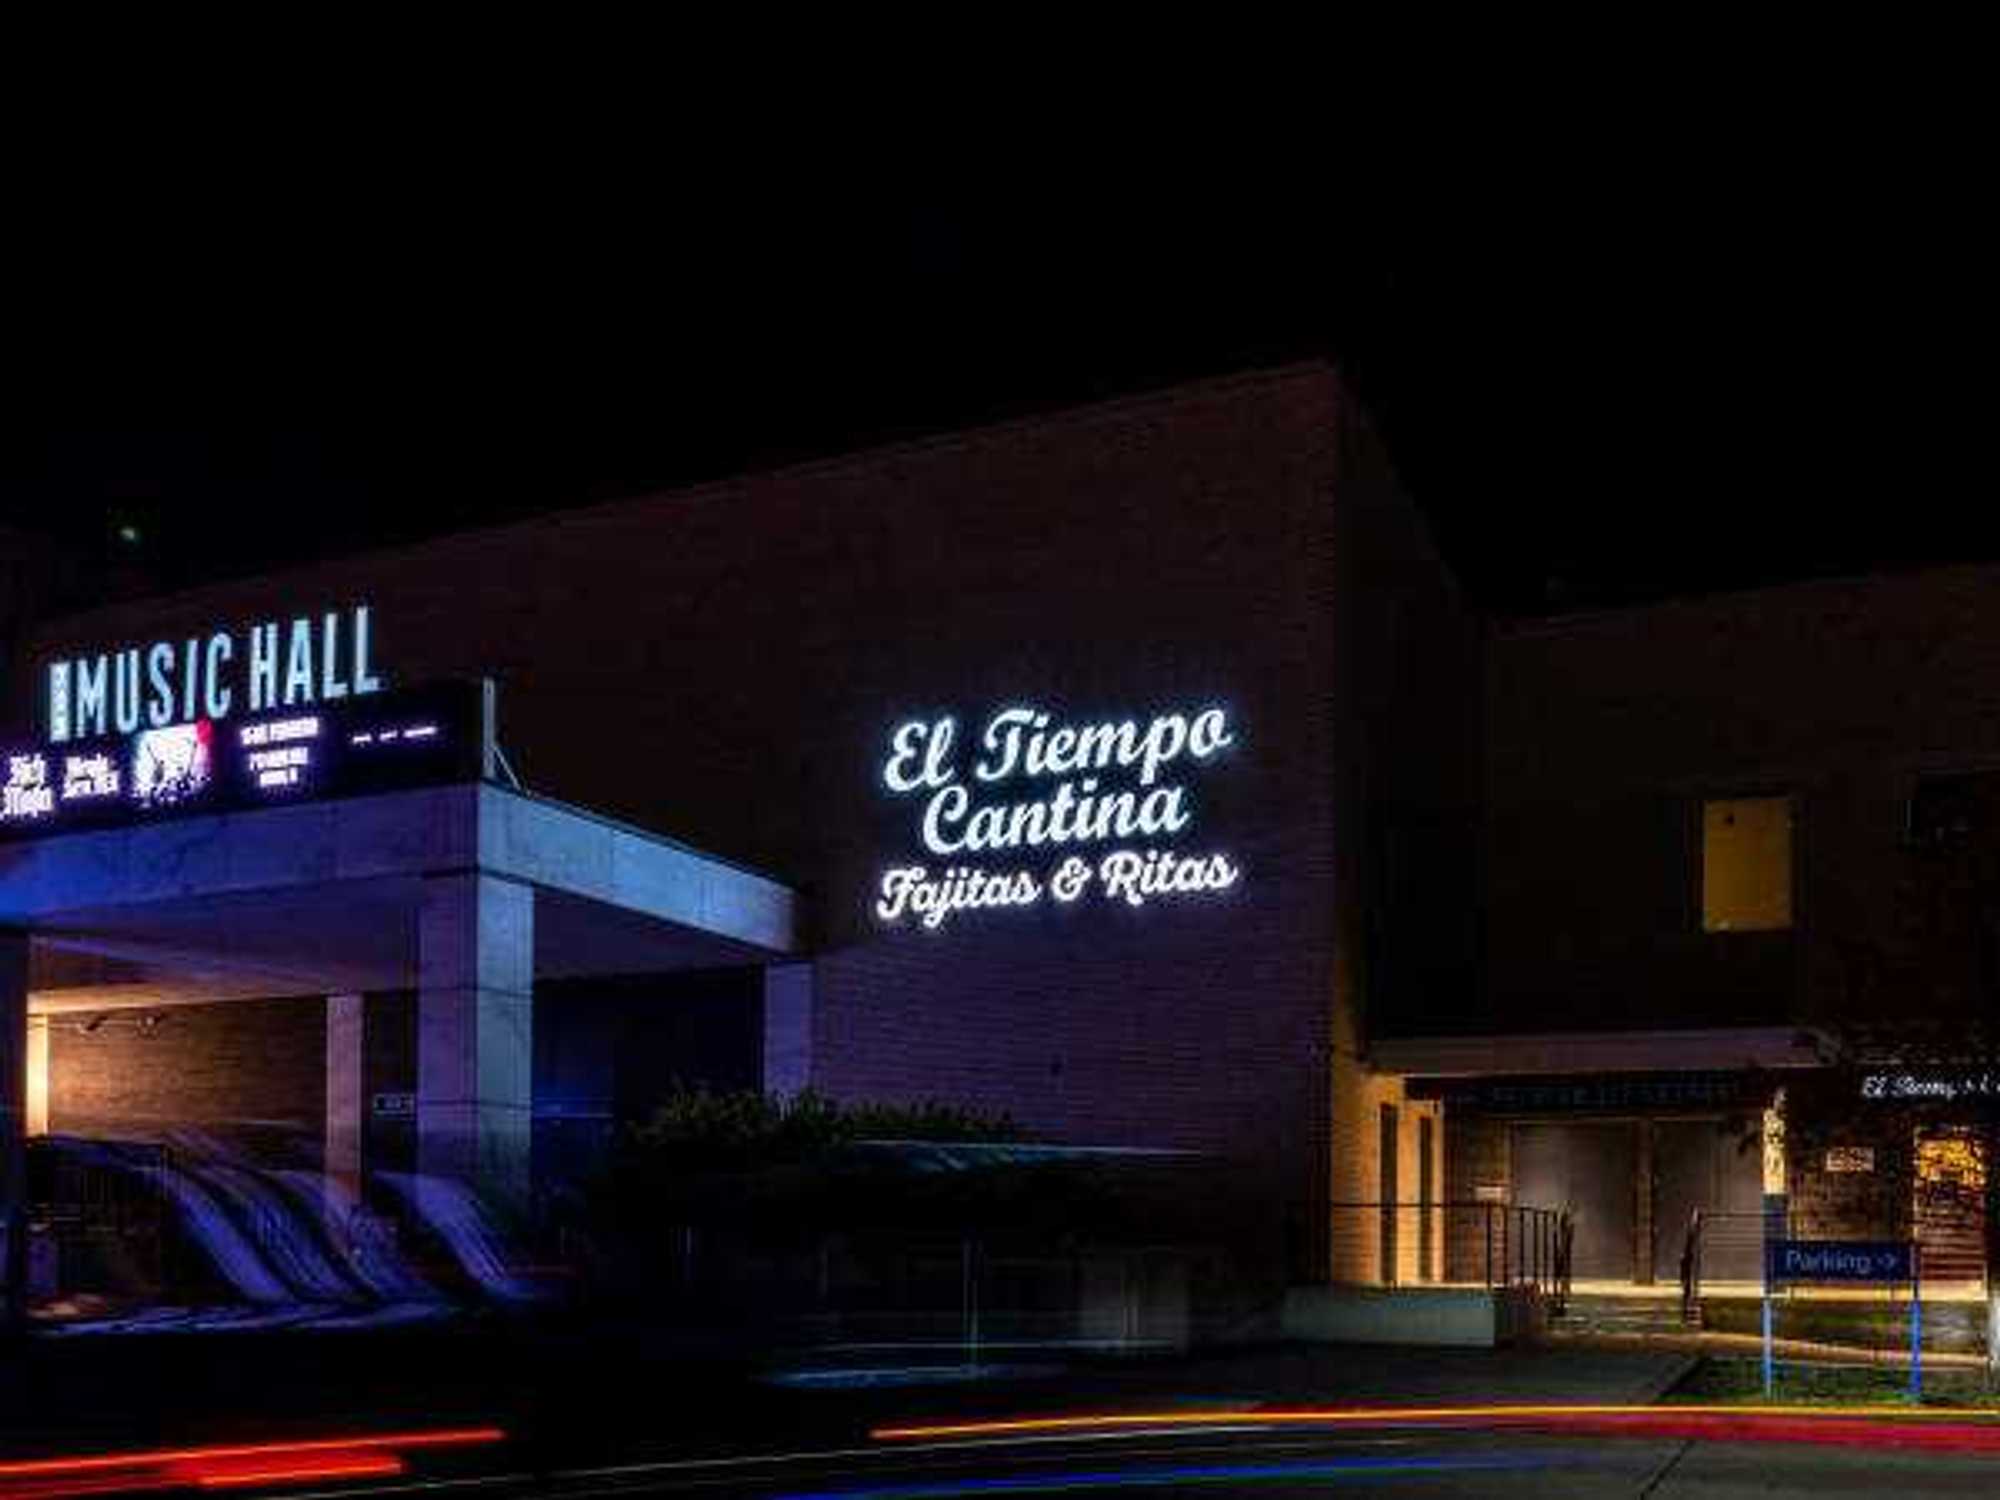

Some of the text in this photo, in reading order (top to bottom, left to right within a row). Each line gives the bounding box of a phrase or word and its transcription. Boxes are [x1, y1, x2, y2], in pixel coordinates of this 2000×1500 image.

[77, 632, 231, 739] MUSIC
[249, 605, 380, 711] HALL
[884, 709, 1232, 792] El Tiempo
[923, 780, 1190, 855] Cantina
[876, 849, 1239, 928] Fajitas & Ritas
[1786, 1248, 1872, 1275] Parking
